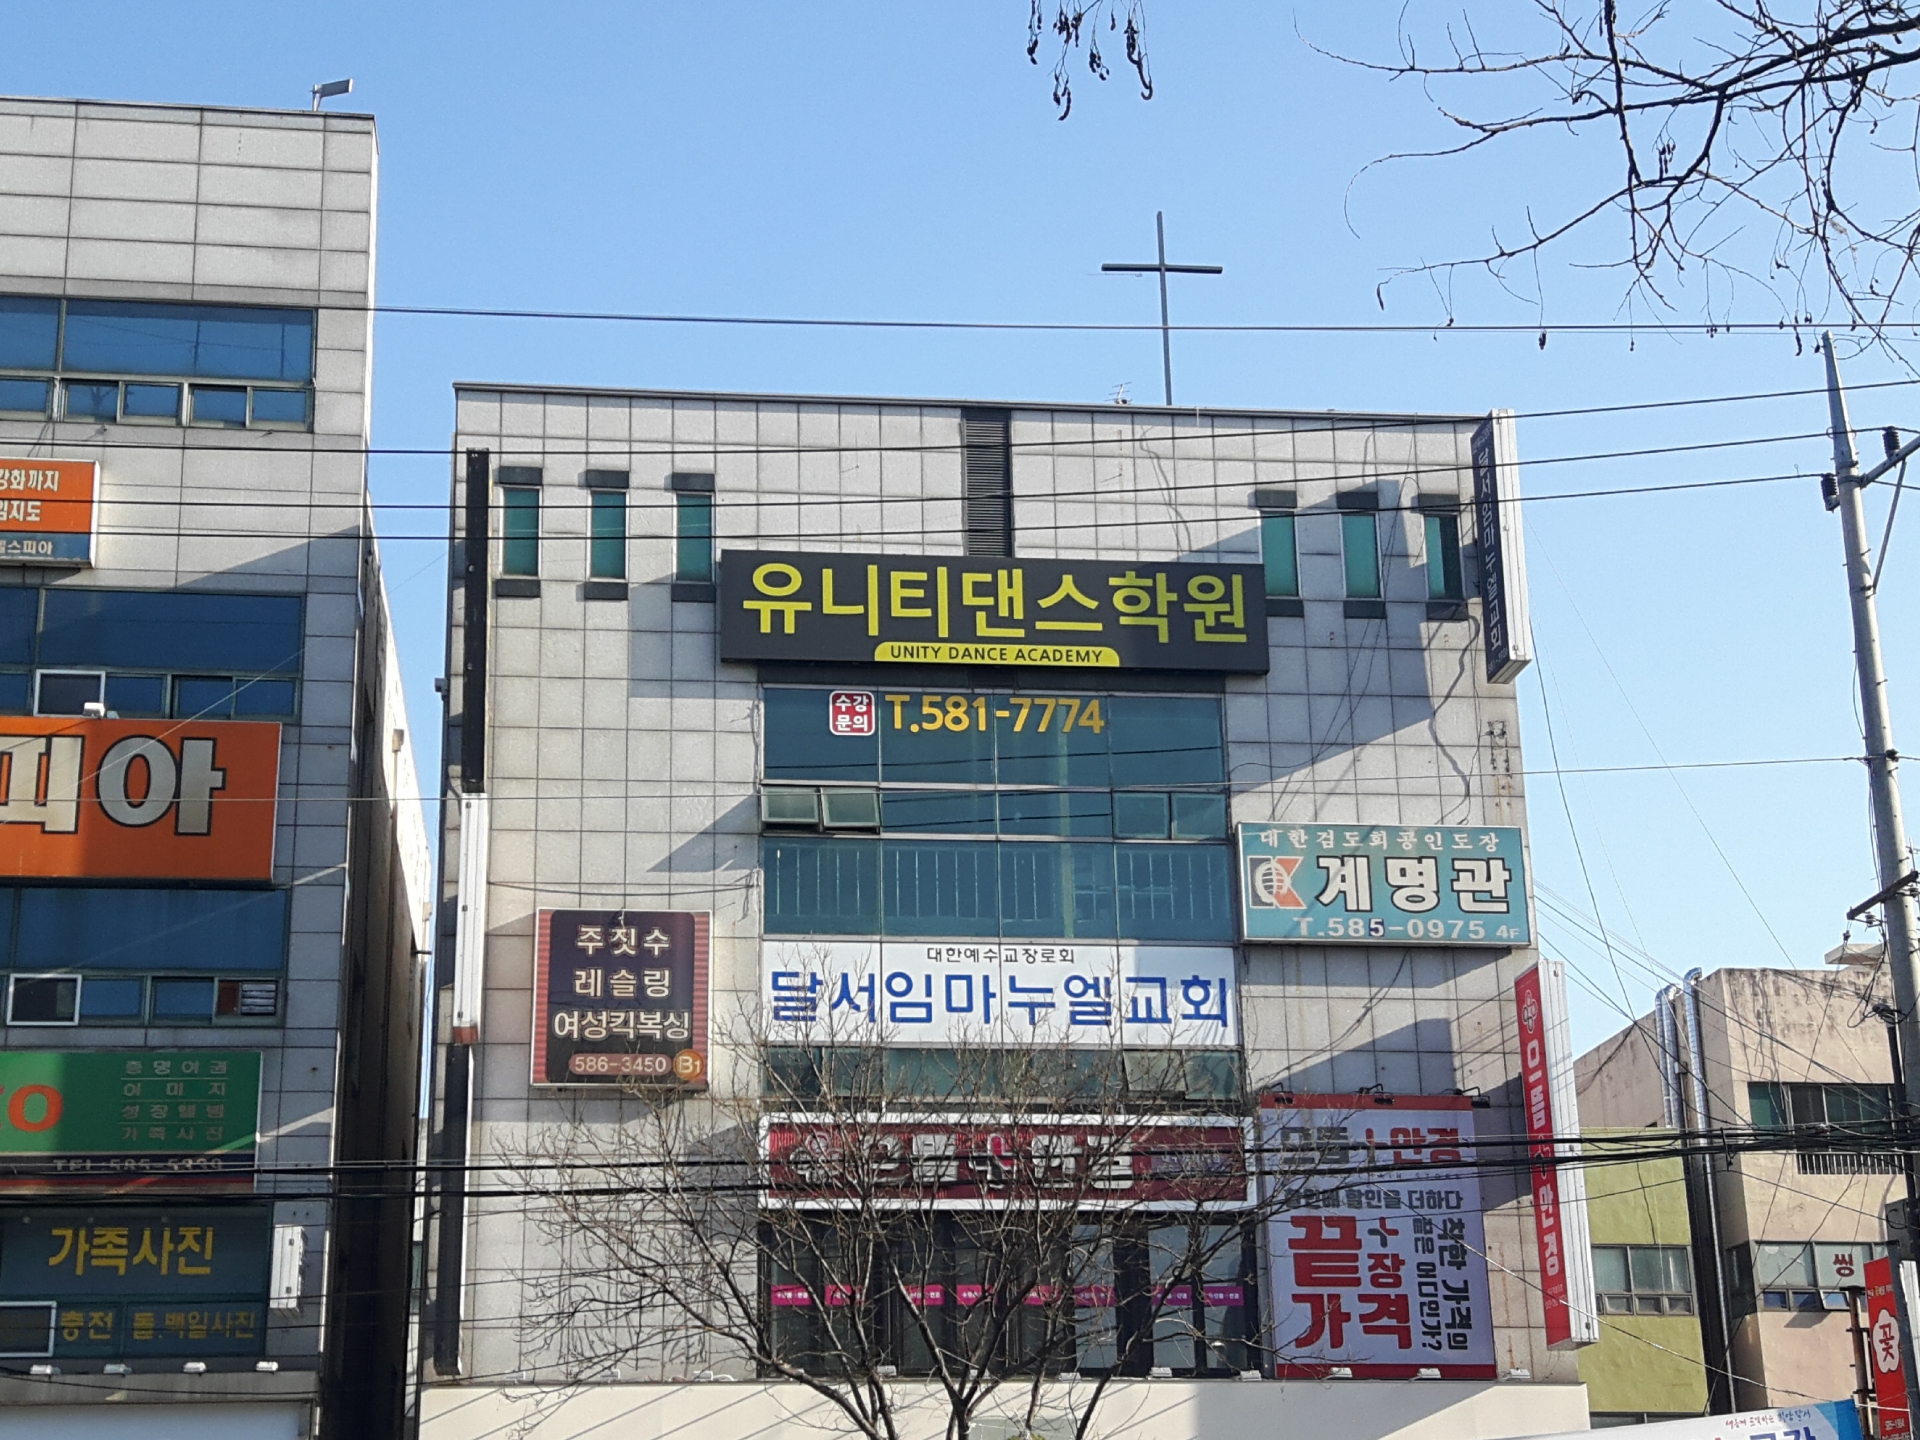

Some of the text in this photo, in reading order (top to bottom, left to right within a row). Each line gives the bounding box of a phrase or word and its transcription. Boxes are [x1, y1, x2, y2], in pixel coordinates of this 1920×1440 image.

[743, 563, 1248, 644] 유니티댄스학원
[891, 645, 1102, 663] UNITY DANCE ACADEMY
[835, 695, 869, 712] 수강
[885, 694, 1104, 733] T.581-7774
[836, 714, 869, 731] 문의
[1315, 855, 1512, 914] 계명관
[577, 925, 670, 956] 주짓수
[1293, 917, 1519, 939] T.585-0975 4F
[927, 946, 1074, 964] 대한예수교장로회
[575, 969, 670, 997] 레슬링
[771, 971, 1227, 1027] 달서임마누엘교회
[554, 1011, 689, 1040] 여성킥복싱
[575, 1055, 701, 1073] 586-3450 B1
[122, 1127, 223, 1141] 가족사진
[1408, 1188, 1464, 1211] 더하다
[49, 1227, 214, 1276] 가족사진
[1291, 1293, 1413, 1350] 가격
[1441, 1279, 1473, 1350] 가격의
